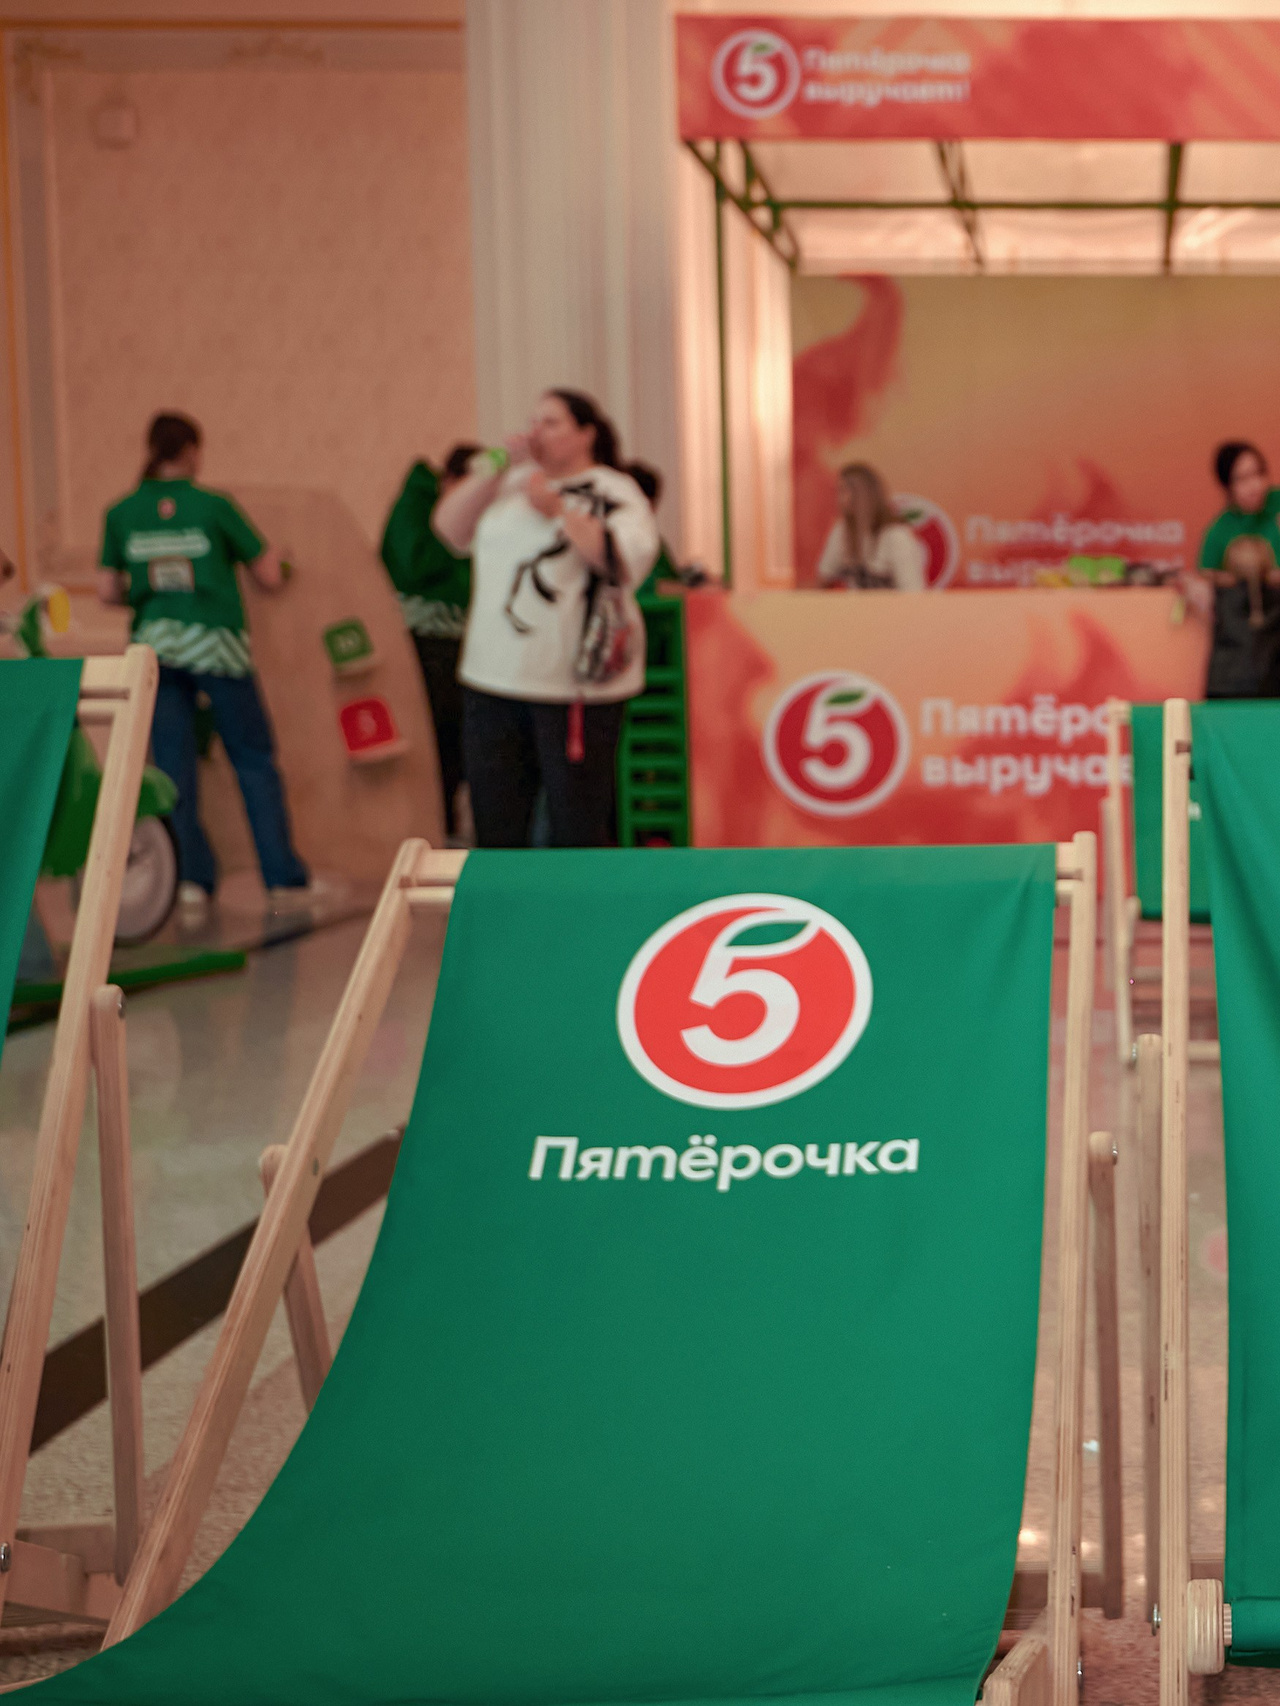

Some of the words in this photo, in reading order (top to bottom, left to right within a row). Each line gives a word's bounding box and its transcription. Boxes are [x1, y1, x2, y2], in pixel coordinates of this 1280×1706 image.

[966, 512, 1184, 548] Пятёрочка
[921, 694, 1110, 744] Пятёро
[528, 1134, 920, 1193] Пятёрочка
